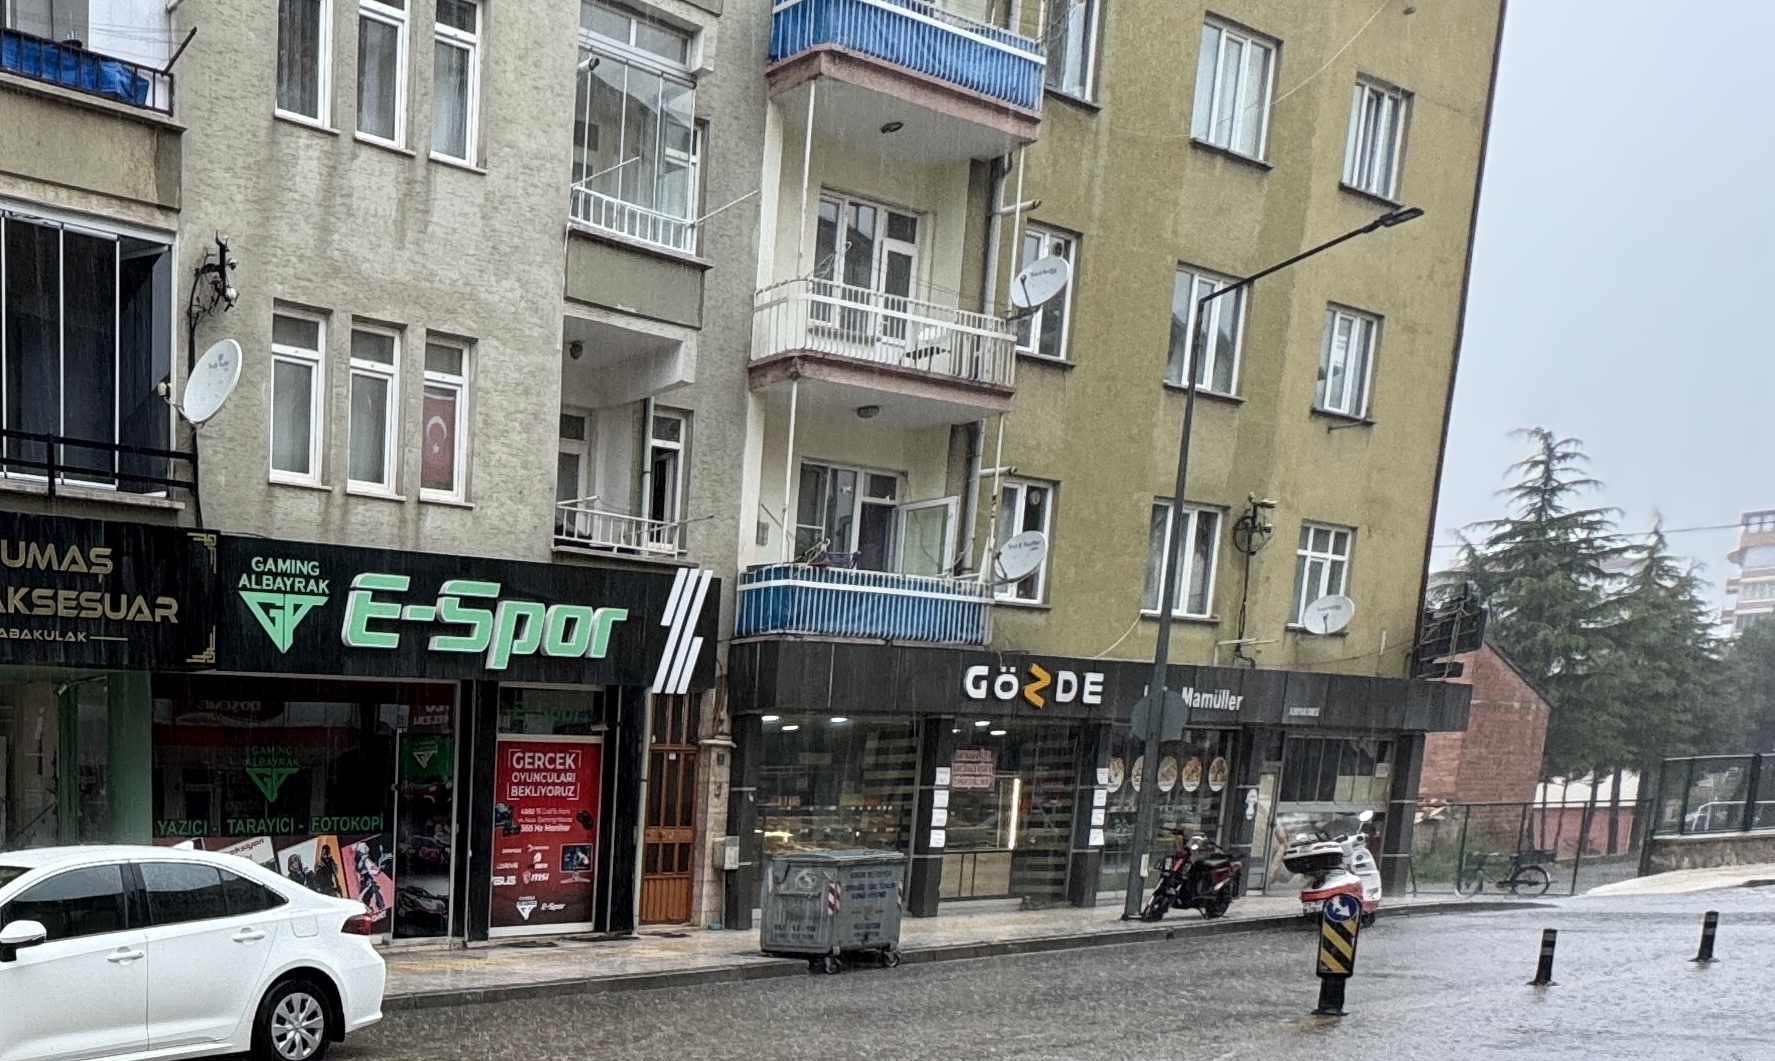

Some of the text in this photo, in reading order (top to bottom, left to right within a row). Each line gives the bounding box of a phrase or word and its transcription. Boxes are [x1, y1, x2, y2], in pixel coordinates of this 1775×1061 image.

[251, 556, 320, 576] GAMING
[238, 573, 330, 595] ALBAYRAK
[341, 572, 629, 670] E-Spor
[1182, 686, 1243, 711] Mamüller
[511, 772, 576, 783] OYUNCULARI
[157, 820, 208, 835] YAZICI
[227, 817, 295, 834] TARAYICI
